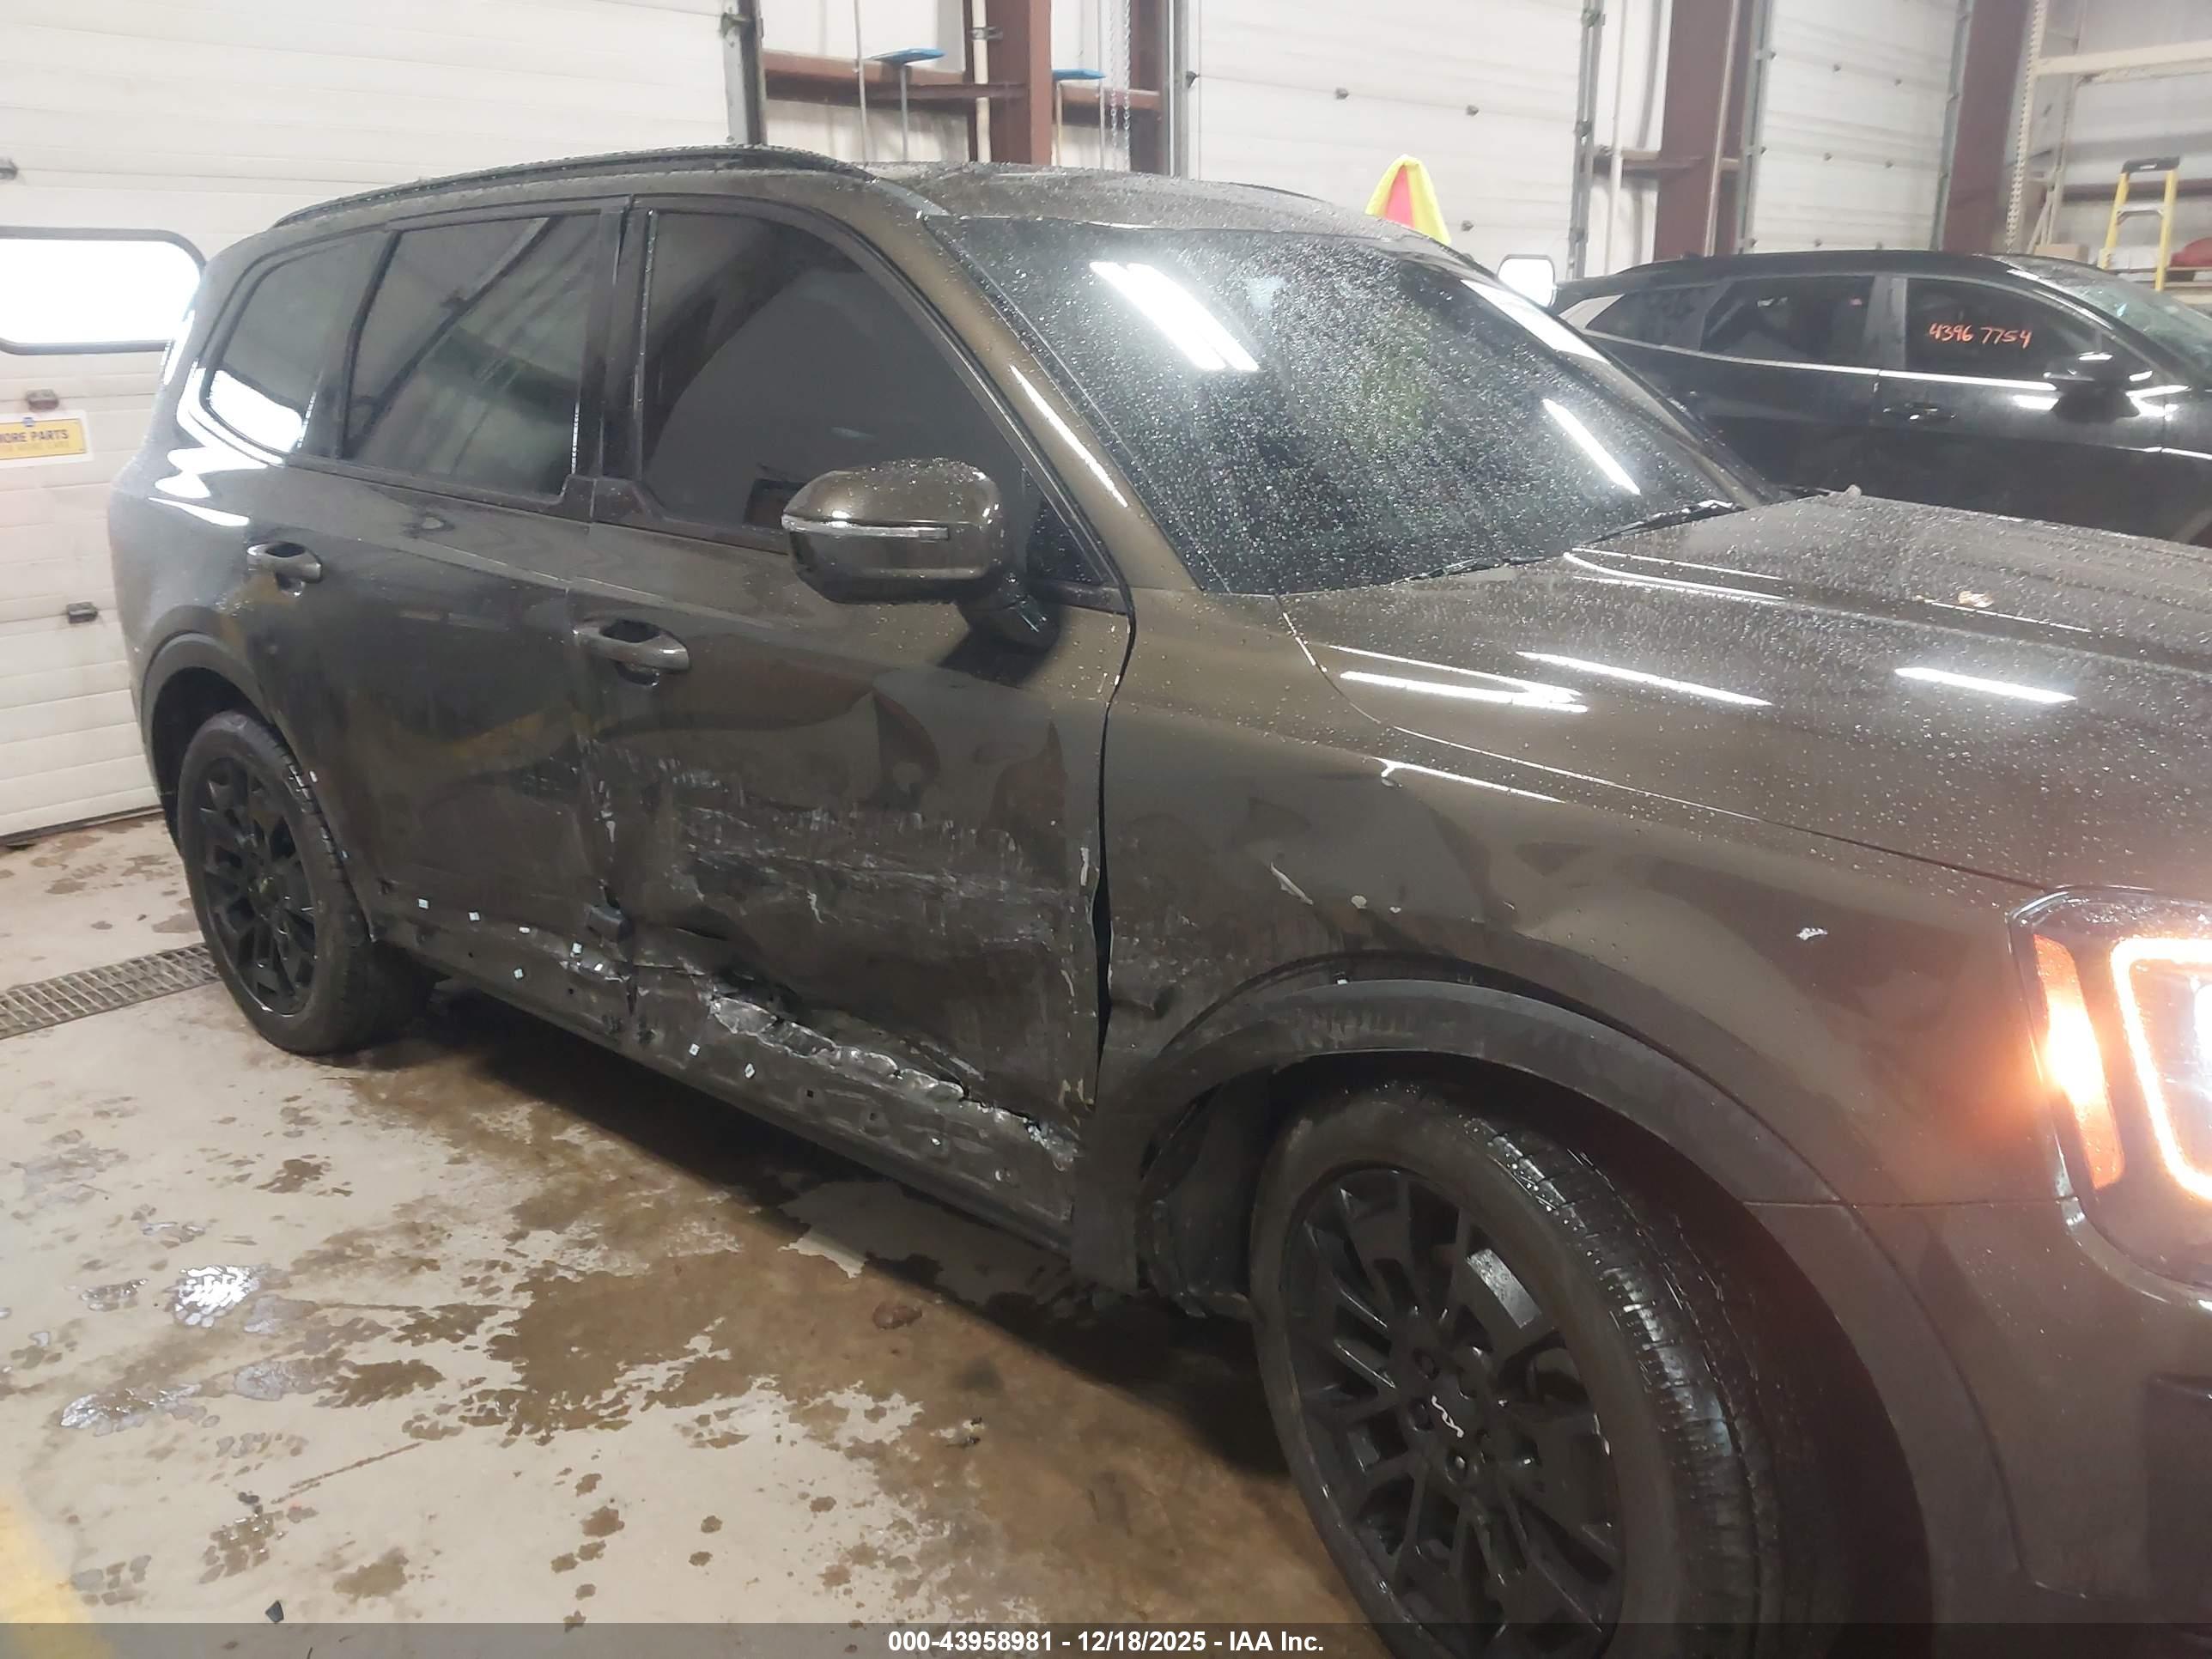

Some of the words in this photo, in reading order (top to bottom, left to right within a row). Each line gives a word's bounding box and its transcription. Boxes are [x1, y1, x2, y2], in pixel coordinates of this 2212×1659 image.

[1929, 322, 1975, 343] 4396
[1980, 326, 2033, 349] 7754
[30, 428, 69, 441] PARTS
